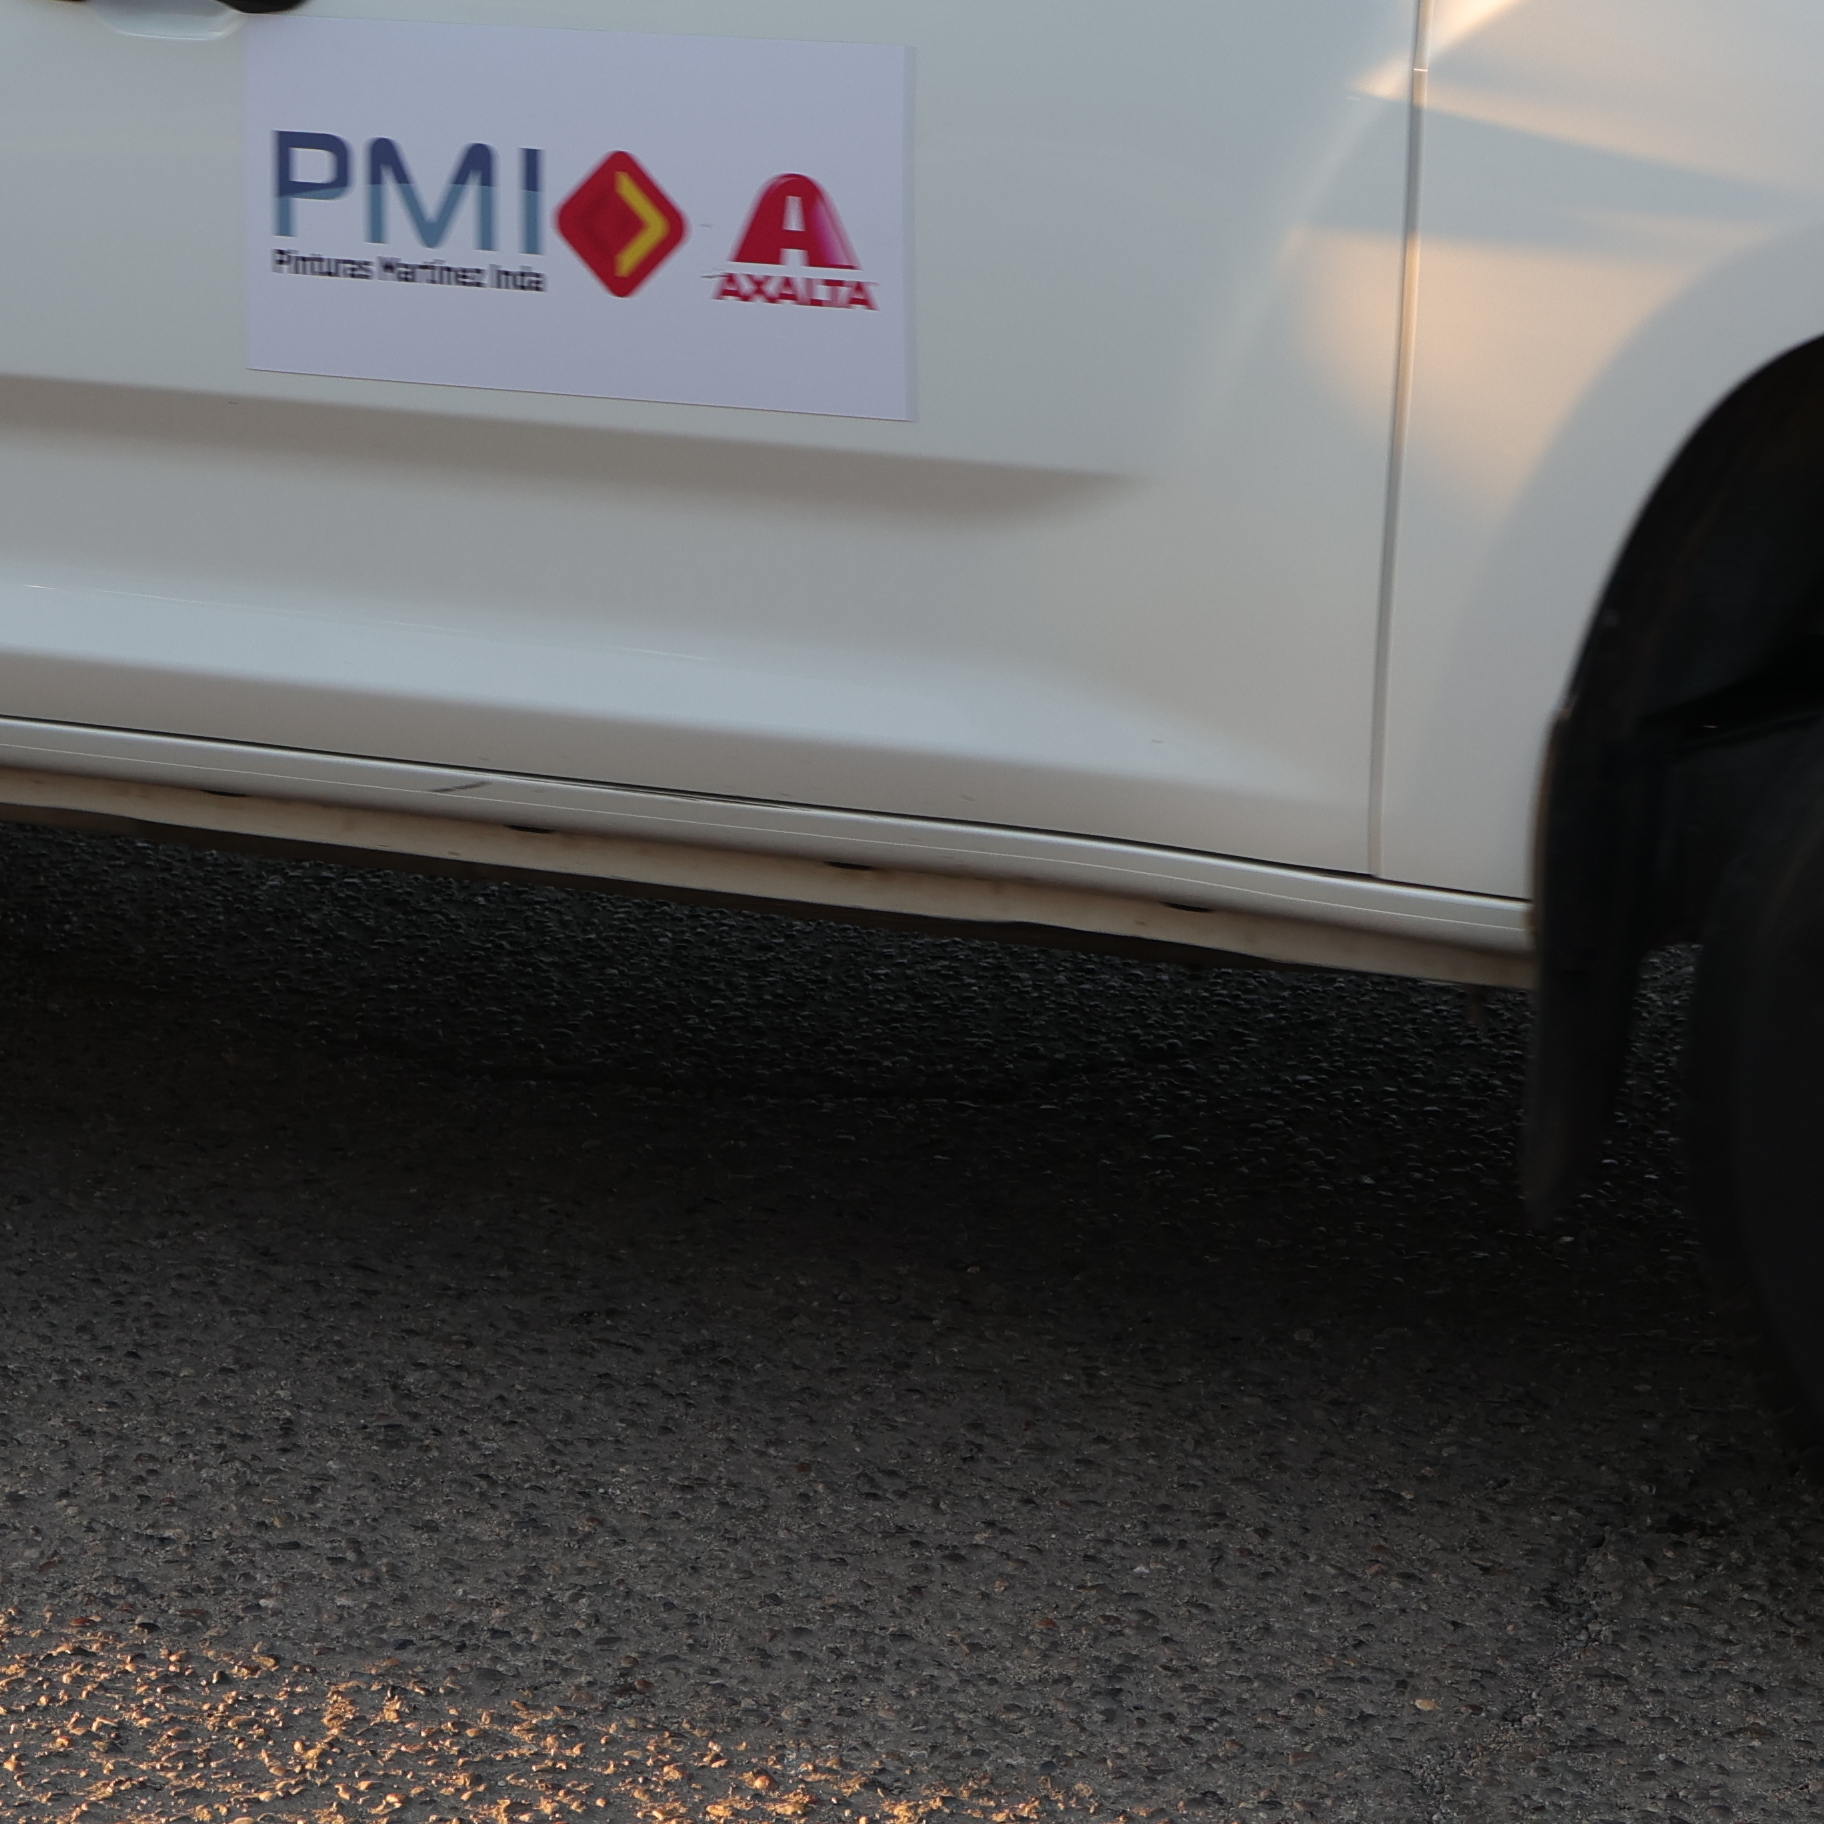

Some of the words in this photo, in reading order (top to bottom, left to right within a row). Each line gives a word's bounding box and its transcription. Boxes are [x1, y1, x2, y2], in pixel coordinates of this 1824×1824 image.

[271, 130, 546, 255] PMI
[271, 248, 374, 280] Pinturas
[712, 272, 880, 311] AXALTA
